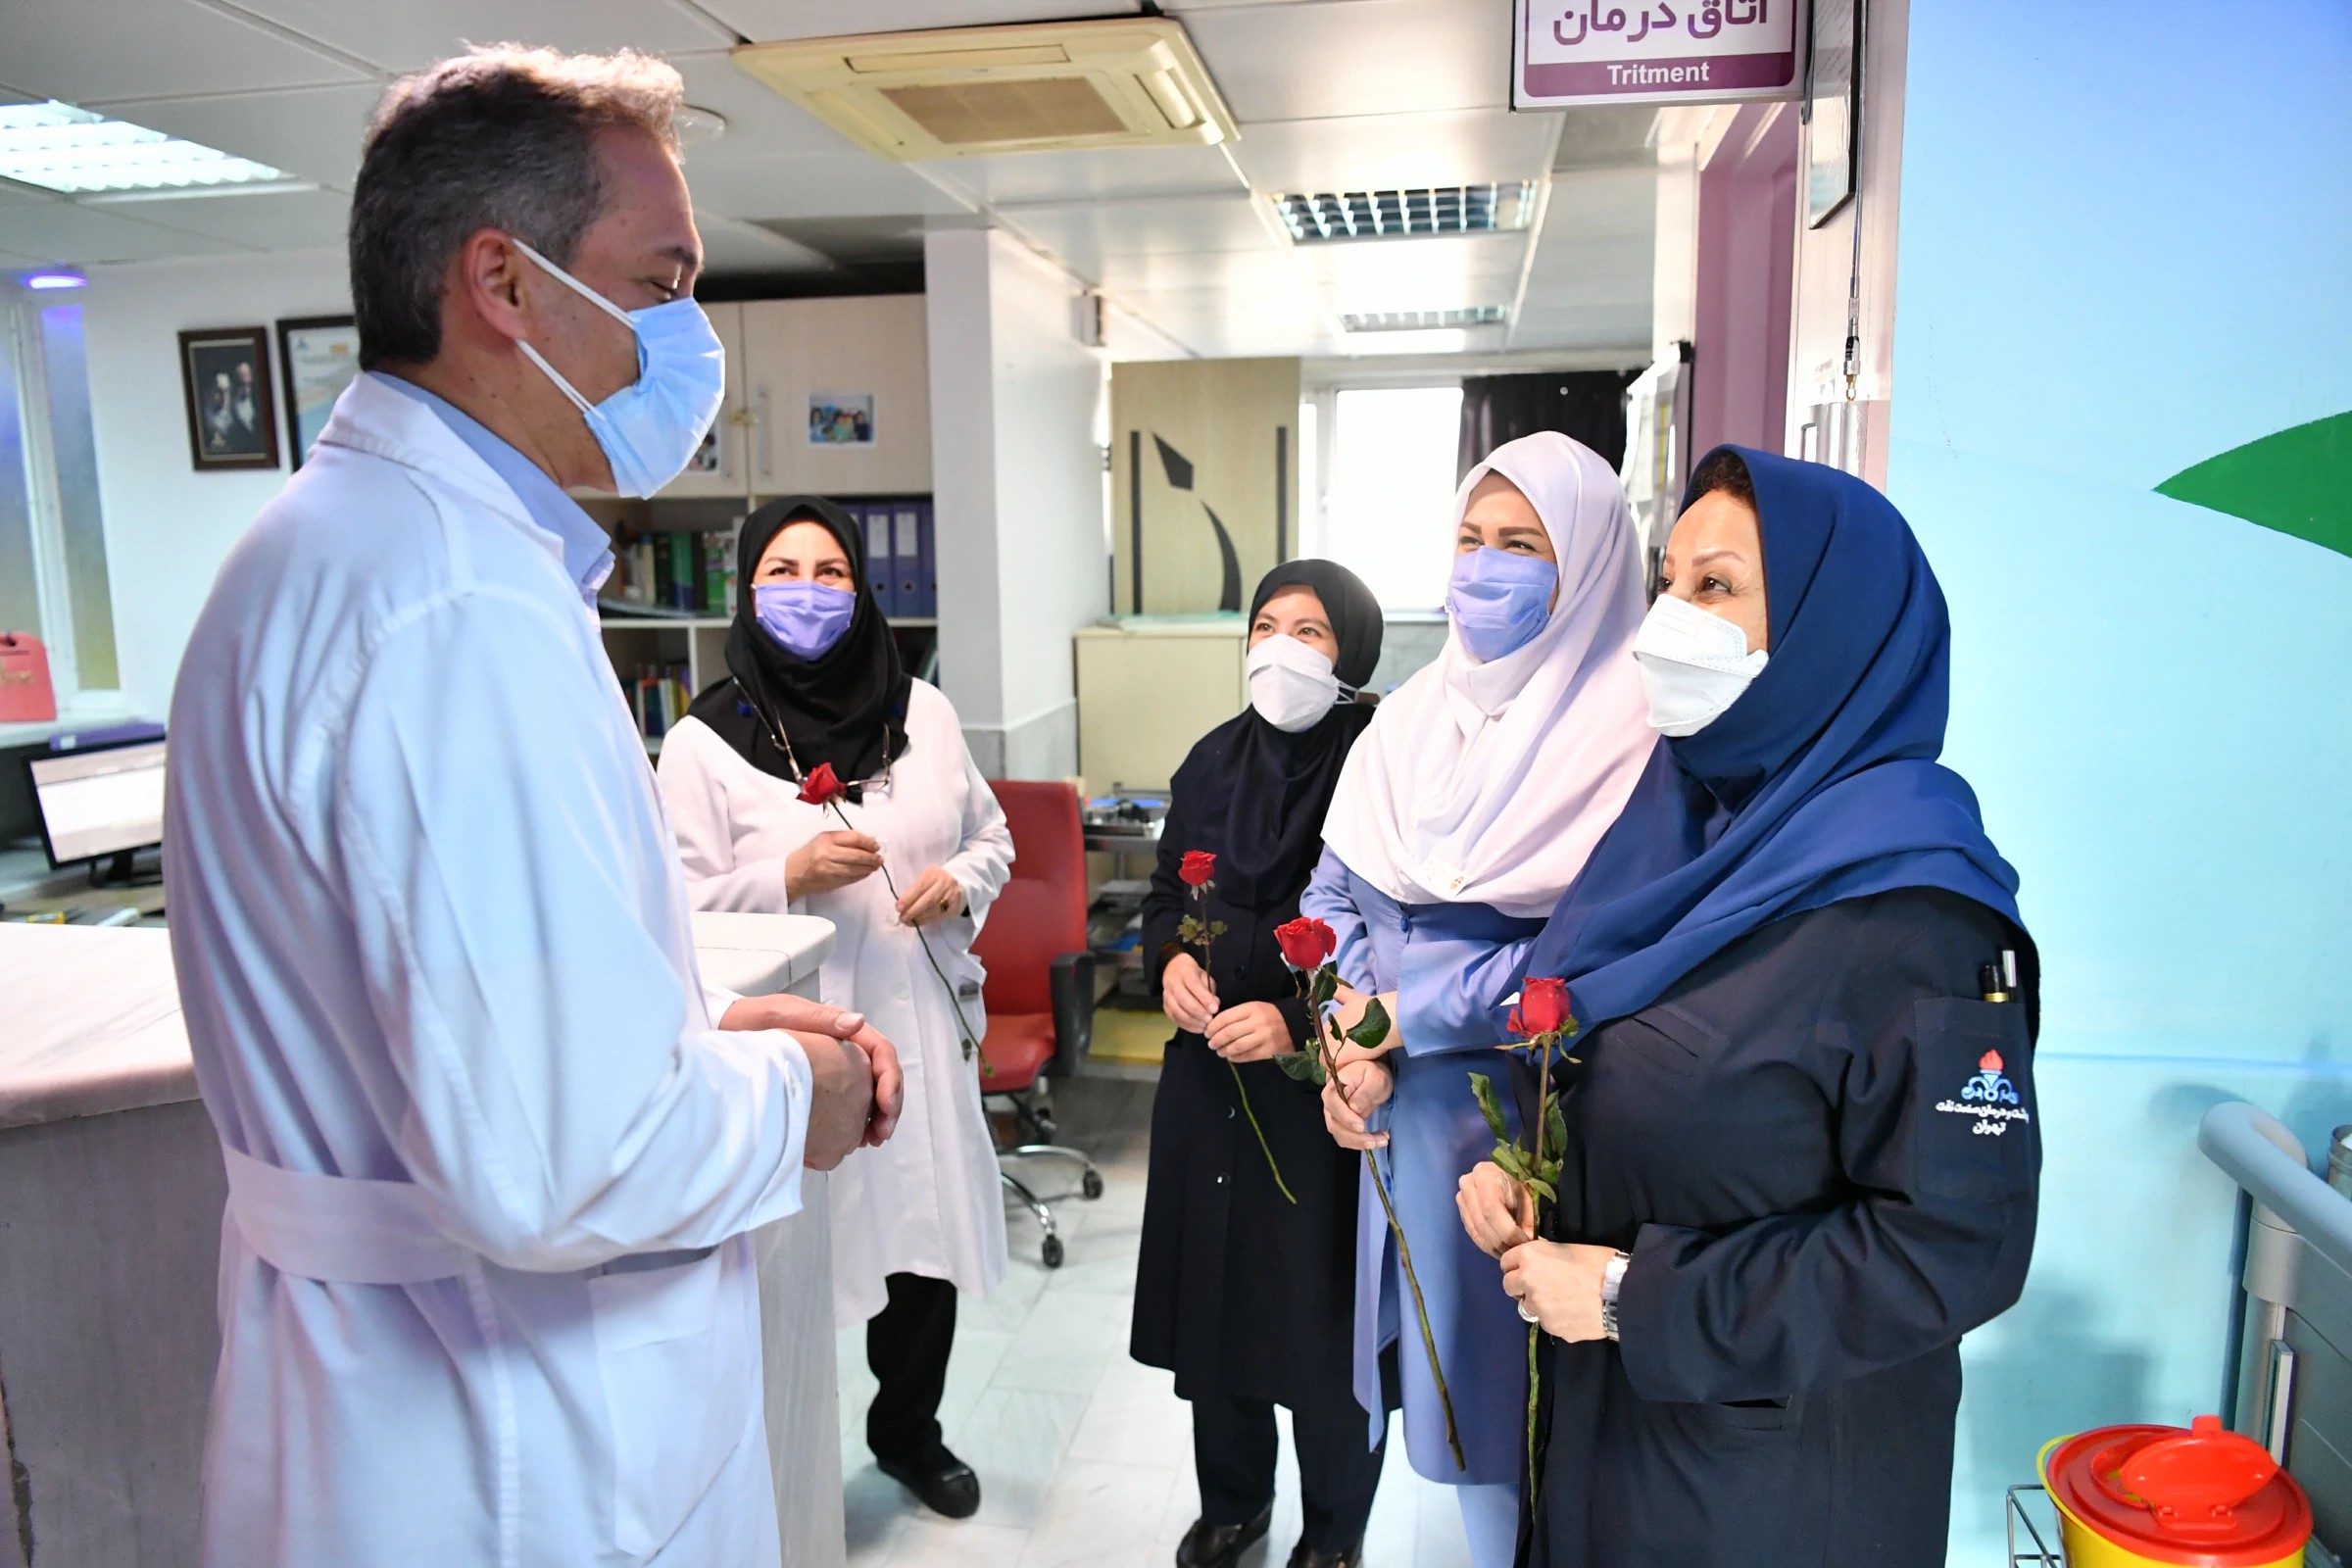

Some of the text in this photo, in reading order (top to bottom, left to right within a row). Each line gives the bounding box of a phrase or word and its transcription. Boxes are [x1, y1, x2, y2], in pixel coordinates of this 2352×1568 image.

[1553, 0, 1767, 46] اتاق درمان
[1607, 62, 1710, 85] Tritment
[1973, 1119, 2007, 1136] تهران
